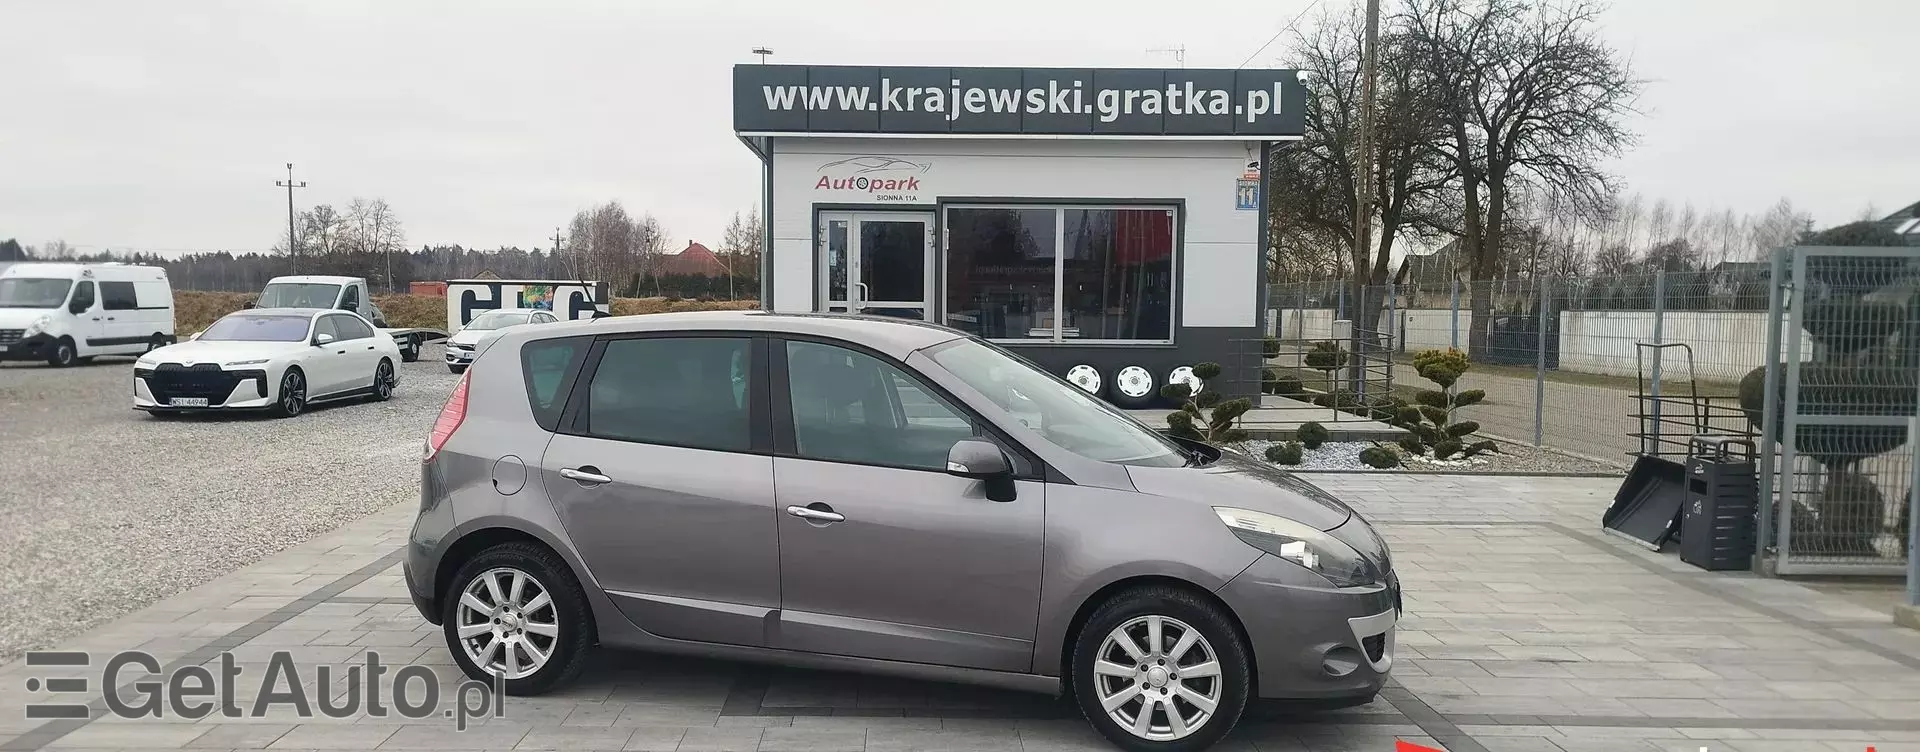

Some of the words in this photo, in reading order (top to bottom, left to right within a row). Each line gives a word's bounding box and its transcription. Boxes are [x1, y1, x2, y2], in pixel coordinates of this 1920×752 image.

[763, 79, 1282, 122] www.krajewski.gratka.pl
[815, 175, 921, 193] Autopark
[876, 194, 903, 202] SIONNA
